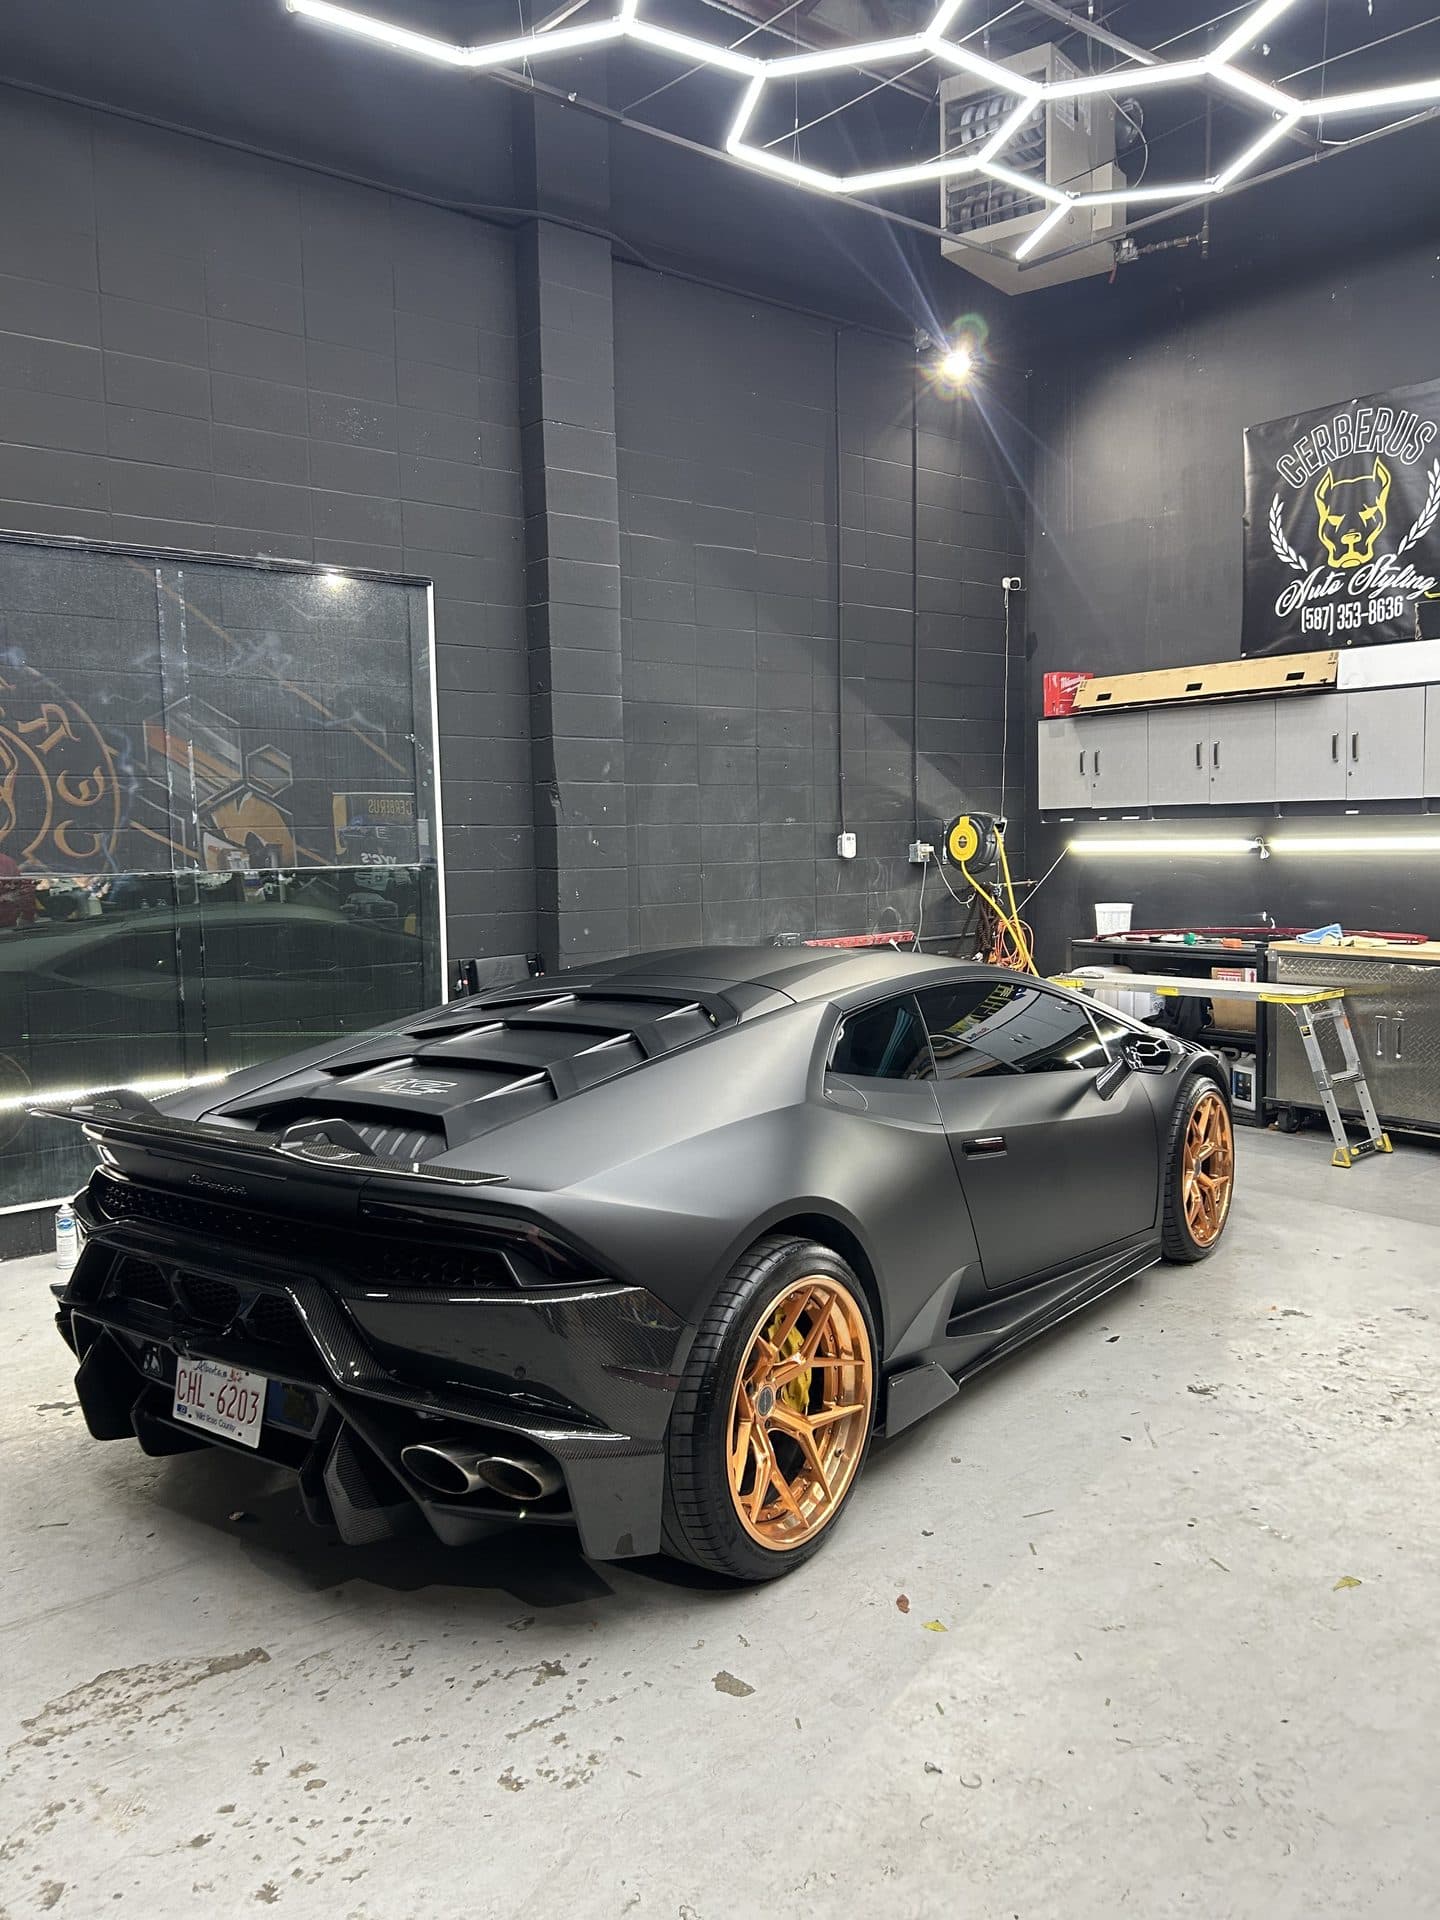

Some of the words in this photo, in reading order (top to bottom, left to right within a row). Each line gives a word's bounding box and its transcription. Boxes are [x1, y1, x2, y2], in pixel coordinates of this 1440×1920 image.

[1276, 407, 1438, 489] CERBERUS
[1275, 565, 1346, 617] Auto
[1347, 553, 1438, 600] Styling
[1301, 603, 1334, 635] (587)
[1336, 595, 1404, 630] 353-8636
[177, 1368, 260, 1425] CHL-6203
